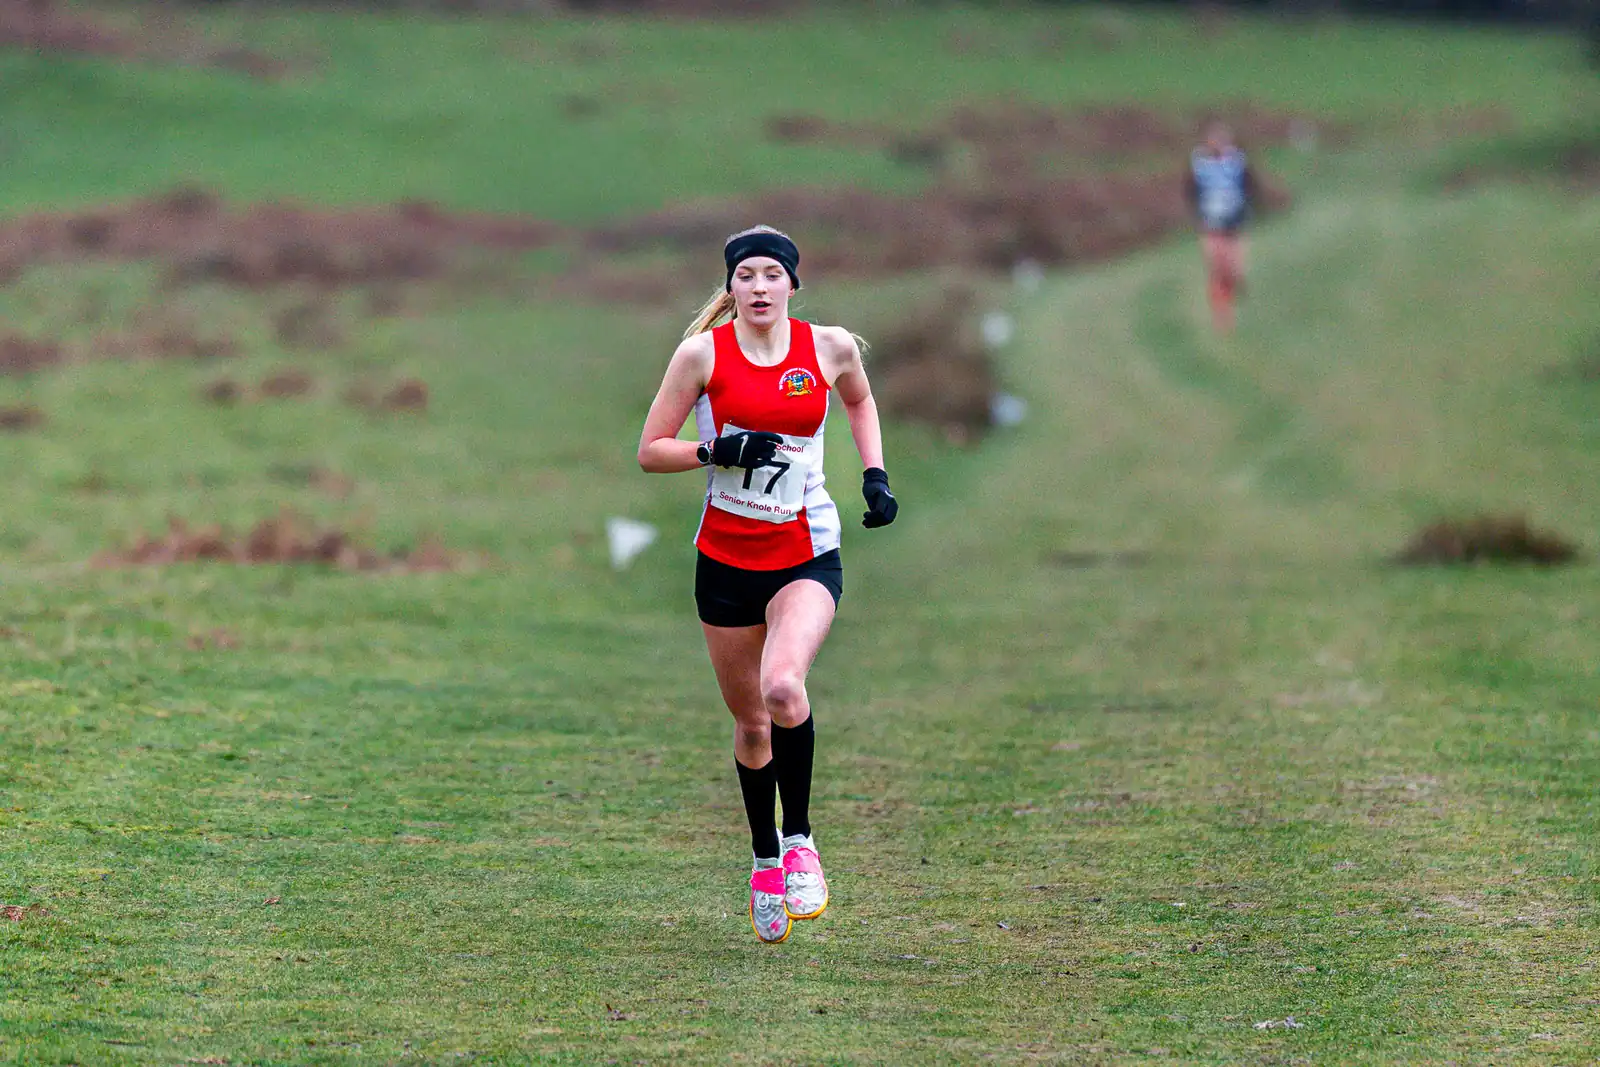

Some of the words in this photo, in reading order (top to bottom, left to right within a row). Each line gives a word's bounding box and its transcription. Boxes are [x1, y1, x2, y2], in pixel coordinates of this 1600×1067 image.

[776, 444, 804, 453] School
[742, 461, 791, 495] 17
[719, 491, 745, 505] Senior
[746, 501, 772, 513] Knole
[773, 506, 792, 515] Run
